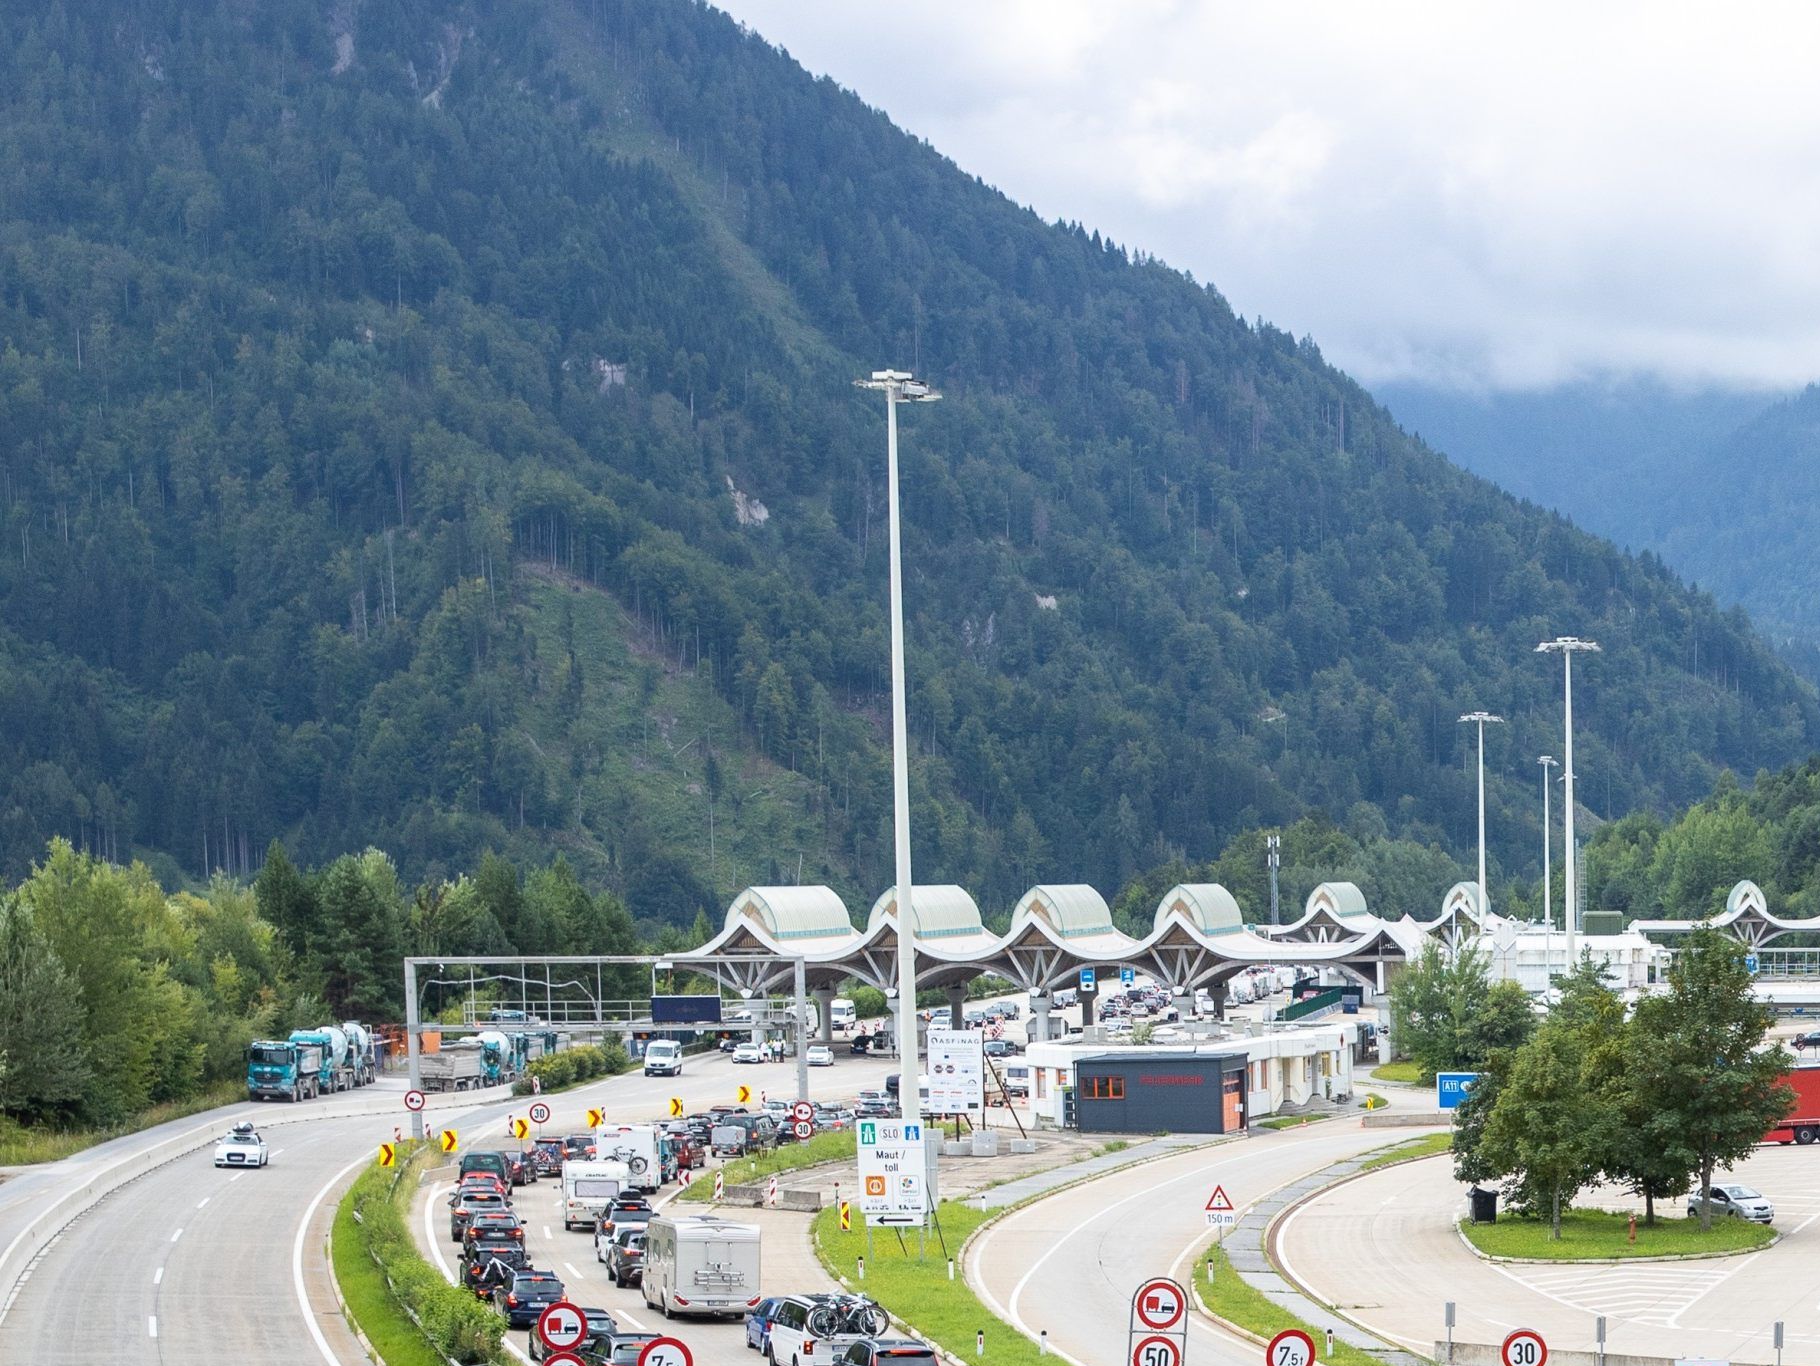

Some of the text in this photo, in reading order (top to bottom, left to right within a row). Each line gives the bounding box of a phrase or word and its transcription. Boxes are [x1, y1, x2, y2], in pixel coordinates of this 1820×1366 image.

[1445, 1082, 1457, 1090] A11
[534, 1108, 545, 1118] 30
[798, 1124, 810, 1135] 30
[882, 1128, 899, 1139] SLO
[875, 1150, 899, 1160] Maut
[884, 1163, 899, 1172] toll
[1207, 1214, 1233, 1224] 150 m
[1513, 1342, 1535, 1365] 30
